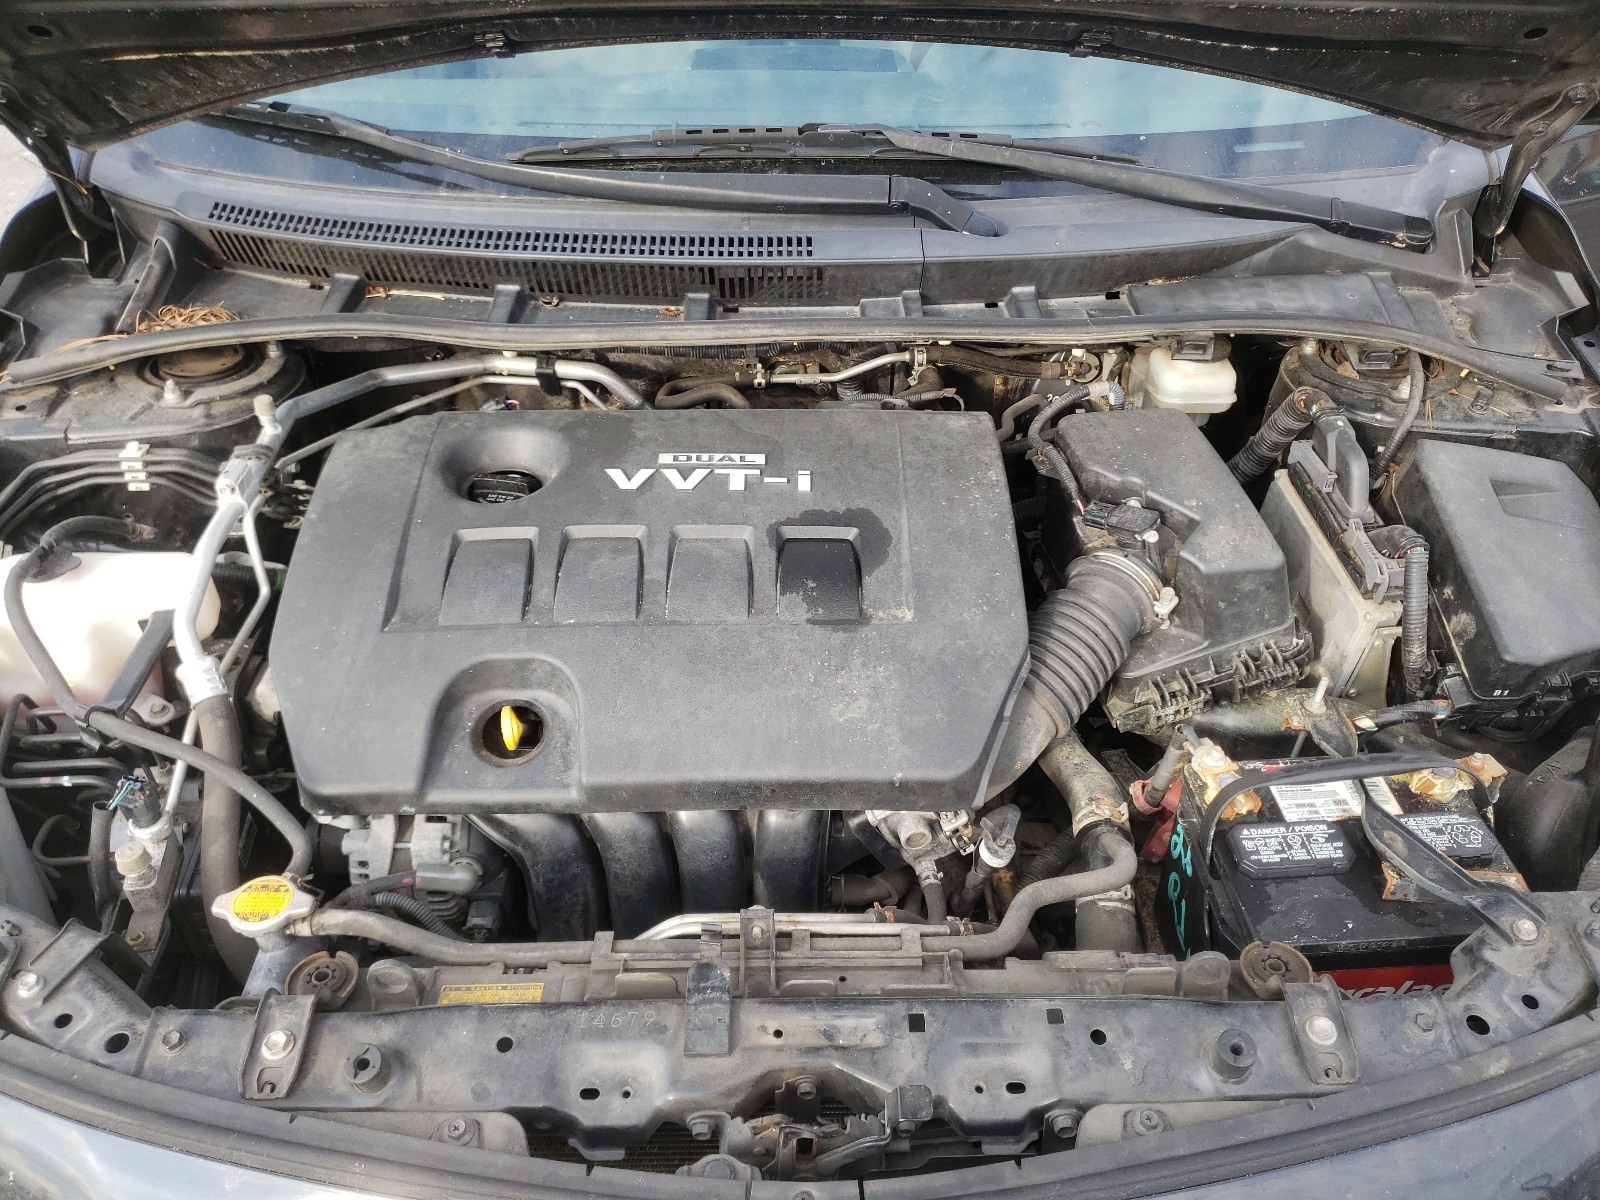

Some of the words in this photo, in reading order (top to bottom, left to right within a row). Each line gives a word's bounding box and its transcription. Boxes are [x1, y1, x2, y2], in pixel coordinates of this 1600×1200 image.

[672, 454, 757, 463] DUAL
[604, 468, 811, 492] VVT-i
[1249, 826, 1287, 835] DANGER
[1294, 824, 1328, 833] POISON
[578, 1011, 657, 1028] 14679
